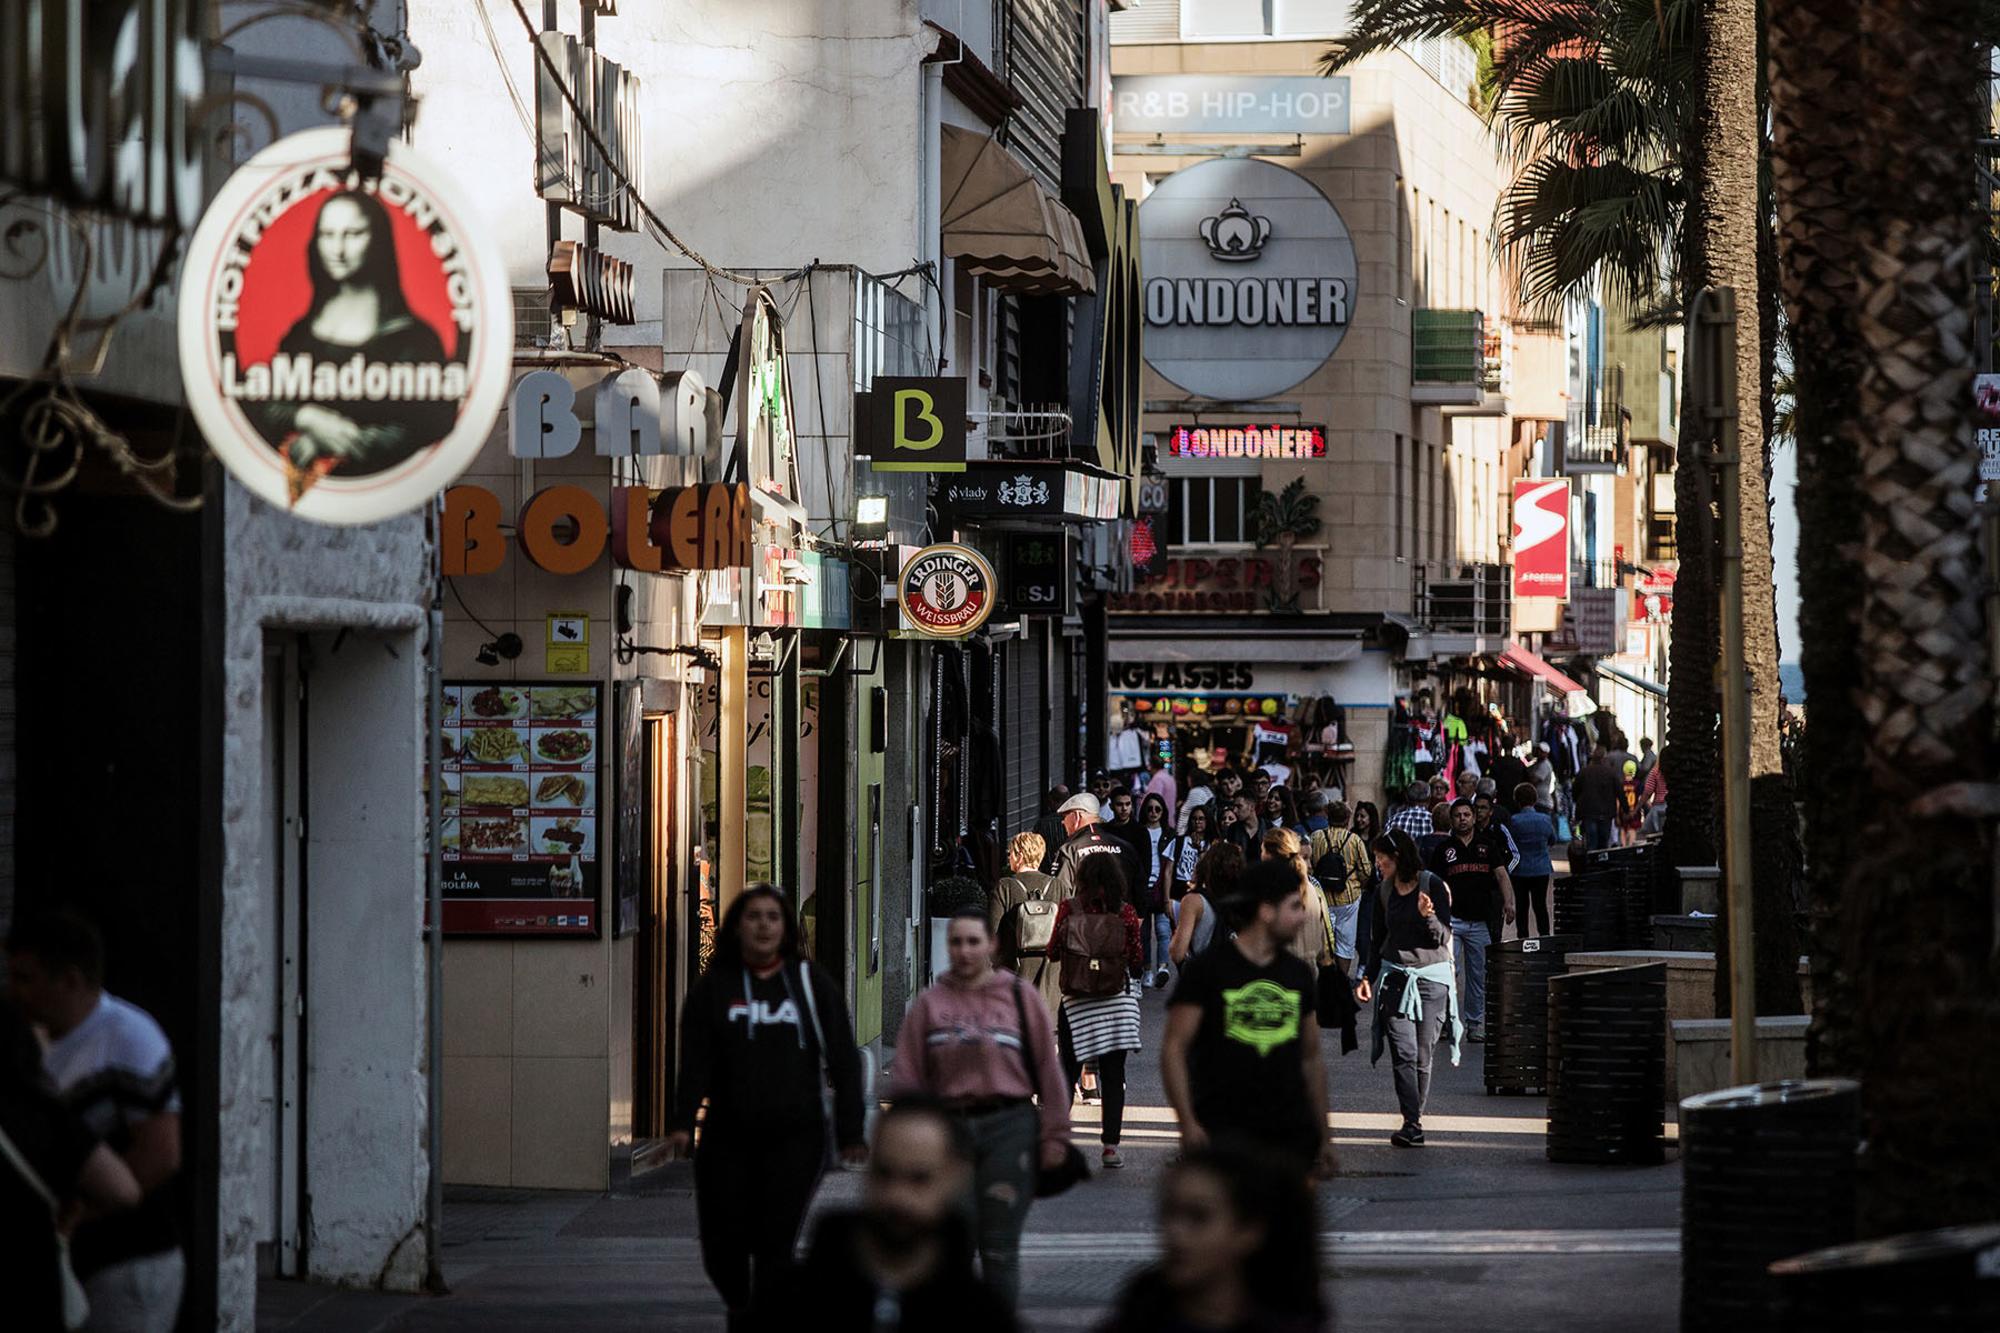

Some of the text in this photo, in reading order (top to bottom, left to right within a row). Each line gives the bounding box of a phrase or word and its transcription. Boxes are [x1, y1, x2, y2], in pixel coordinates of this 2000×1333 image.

[1118, 91, 1342, 118] R&B HIP-HOP
[216, 242, 252, 332] HOT
[240, 167, 342, 246] PIZZA
[1143, 277, 1348, 327] ONDONER
[221, 351, 468, 401] LaMadonna
[508, 369, 708, 458] BAR
[894, 388, 944, 450] B
[1179, 427, 1313, 459] LONDONER
[441, 481, 753, 577] BOLERA
[909, 556, 979, 587] ERDINGER
[1078, 845, 1122, 858] PETRONAS
[453, 871, 468, 881] LA
[728, 999, 799, 1024] FILA
